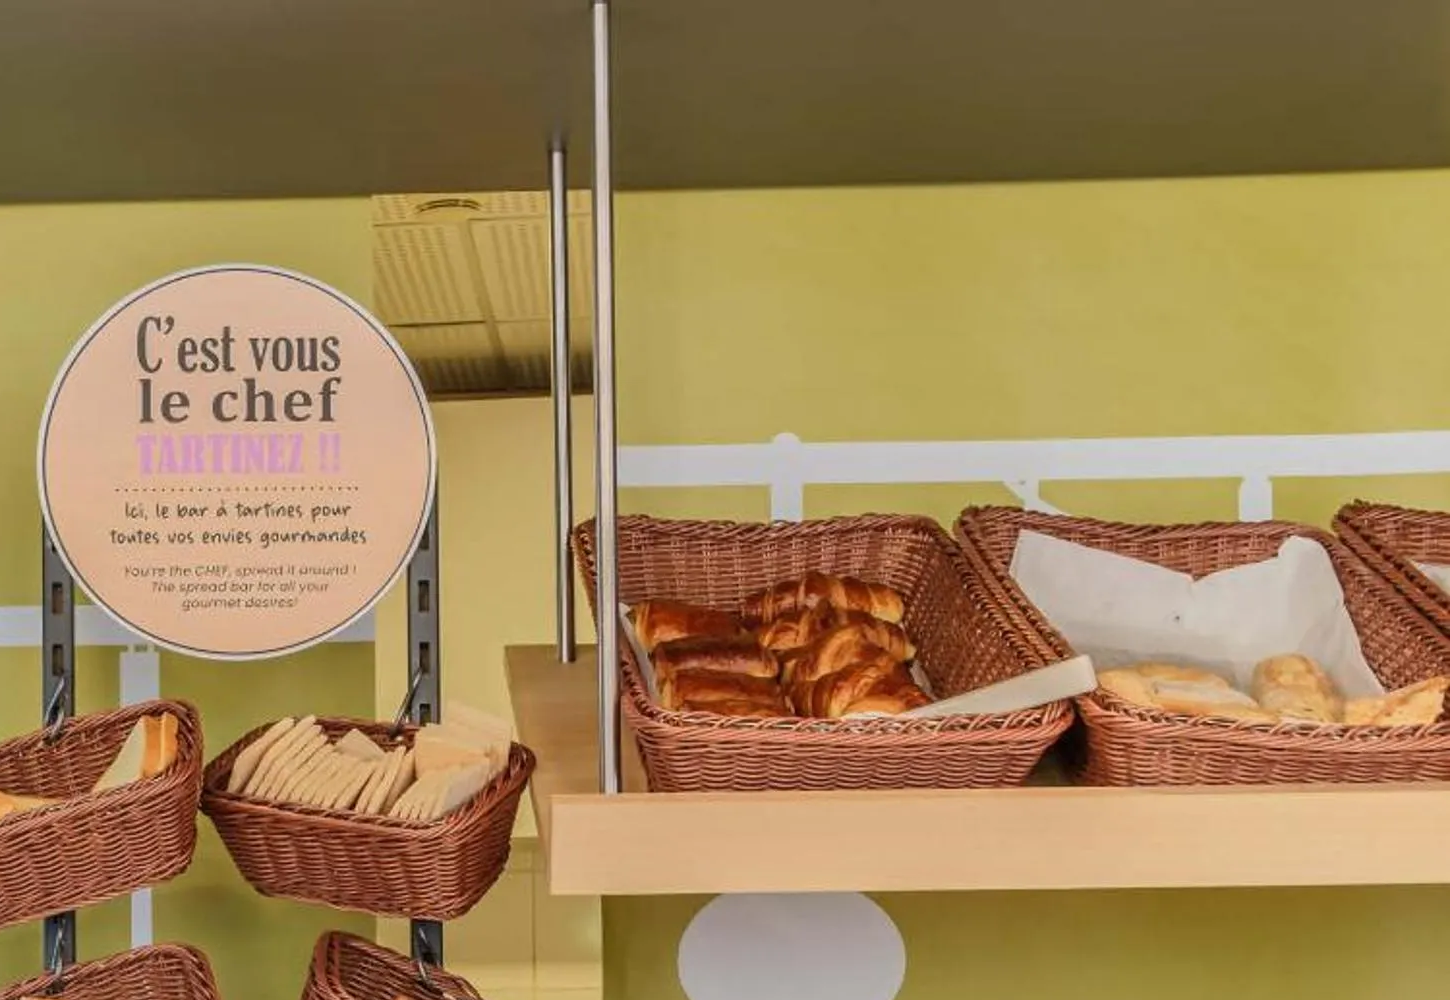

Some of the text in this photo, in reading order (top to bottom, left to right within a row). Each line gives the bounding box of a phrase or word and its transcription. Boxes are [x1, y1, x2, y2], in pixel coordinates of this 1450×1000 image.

[136, 316, 341, 373] C'est vous
[139, 377, 341, 423] le chef
[136, 432, 341, 474] TARTINEZ !!
[125, 500, 351, 523] Ici, le bar à tartines pour
[111, 528, 367, 548] toutes vos envies gourmandes
[169, 565, 192, 577] the
[299, 564, 349, 576] around
[152, 580, 329, 596] The spread bar for all your
[182, 598, 240, 612] gourmet
